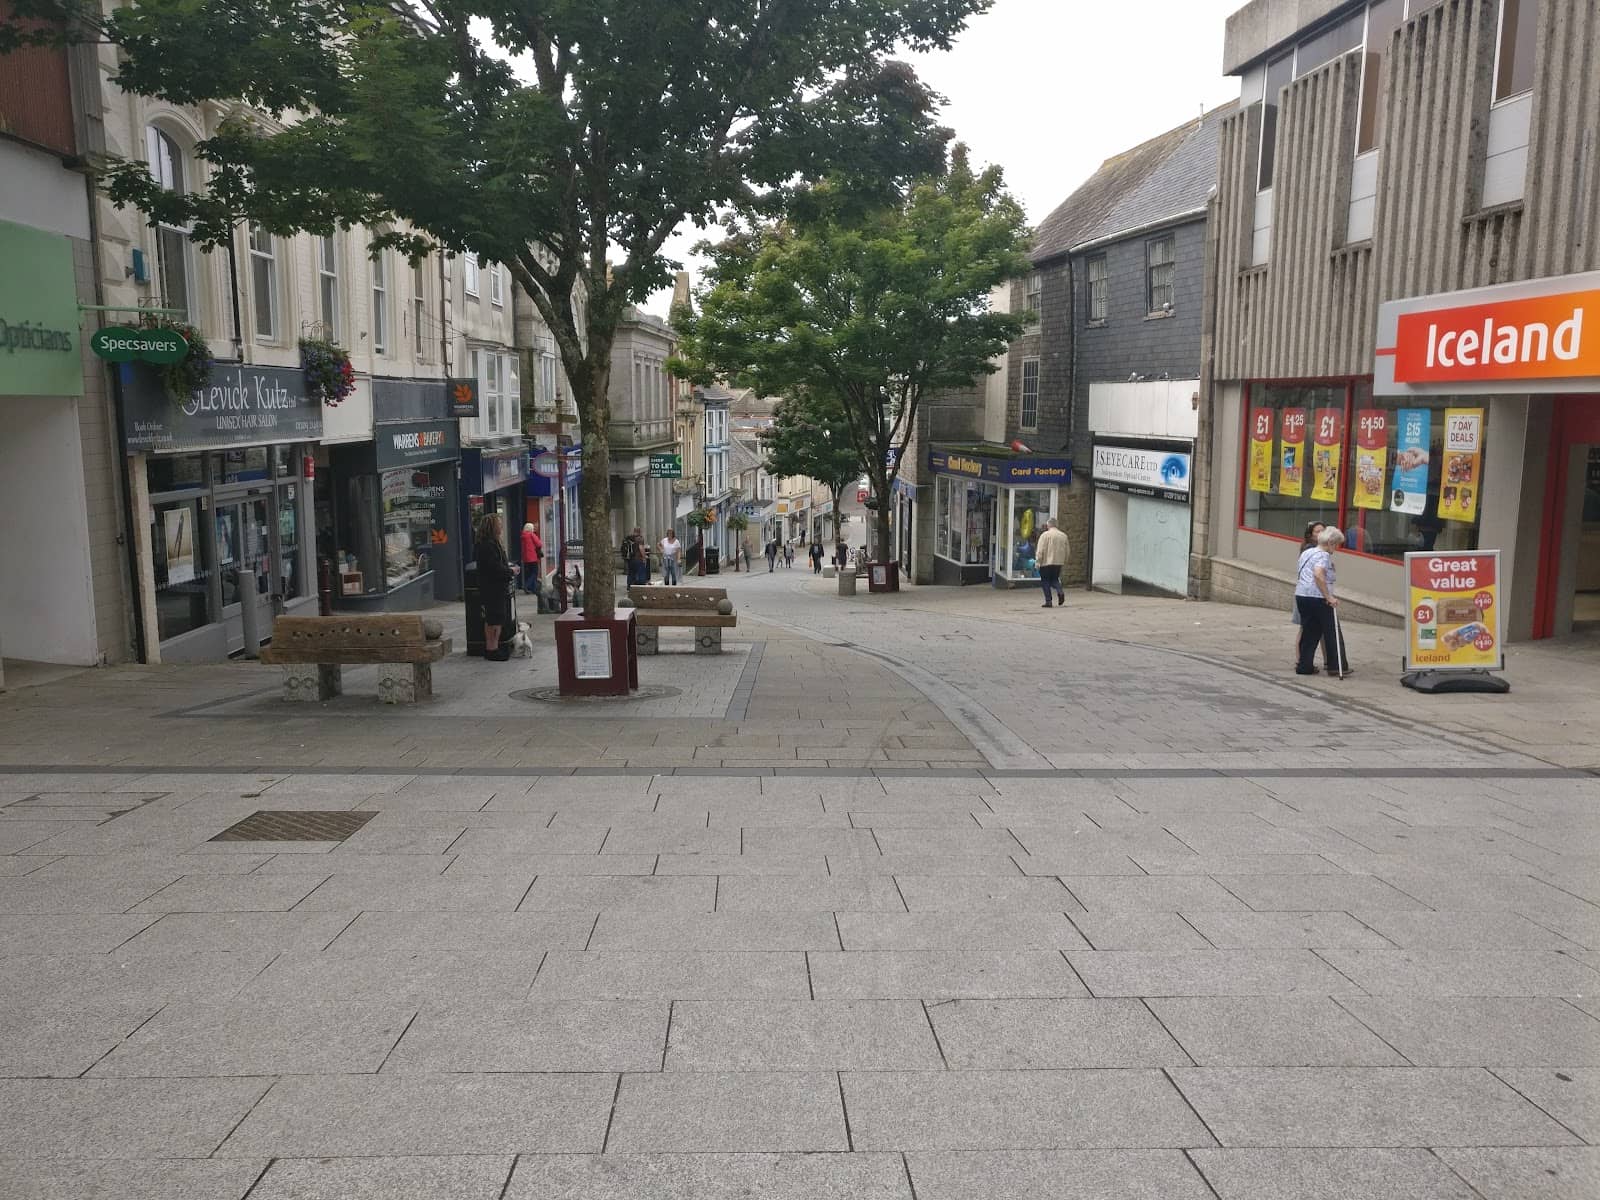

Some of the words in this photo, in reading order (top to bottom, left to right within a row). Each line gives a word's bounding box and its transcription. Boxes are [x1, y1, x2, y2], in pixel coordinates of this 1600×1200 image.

[100, 336, 177, 352] Specsavers
[1426, 308, 1584, 368] Iceland
[200, 369, 250, 411] Levick
[254, 375, 288, 410] Kutz
[216, 415, 241, 430] UNISEX
[241, 414, 258, 429] HAIR
[258, 414, 278, 428] SALON
[1257, 415, 1269, 434] £1
[1320, 416, 1335, 438] £1
[1453, 421, 1458, 430] 7
[1459, 421, 1473, 431] DAY
[393, 432, 419, 450] WARRENS
[1450, 432, 1474, 443] DEALS
[1011, 468, 1031, 476] Card
[1034, 467, 1066, 476] Factory
[1428, 557, 1478, 573] Great
[1431, 573, 1476, 589] value
[1417, 609, 1431, 620] £1
